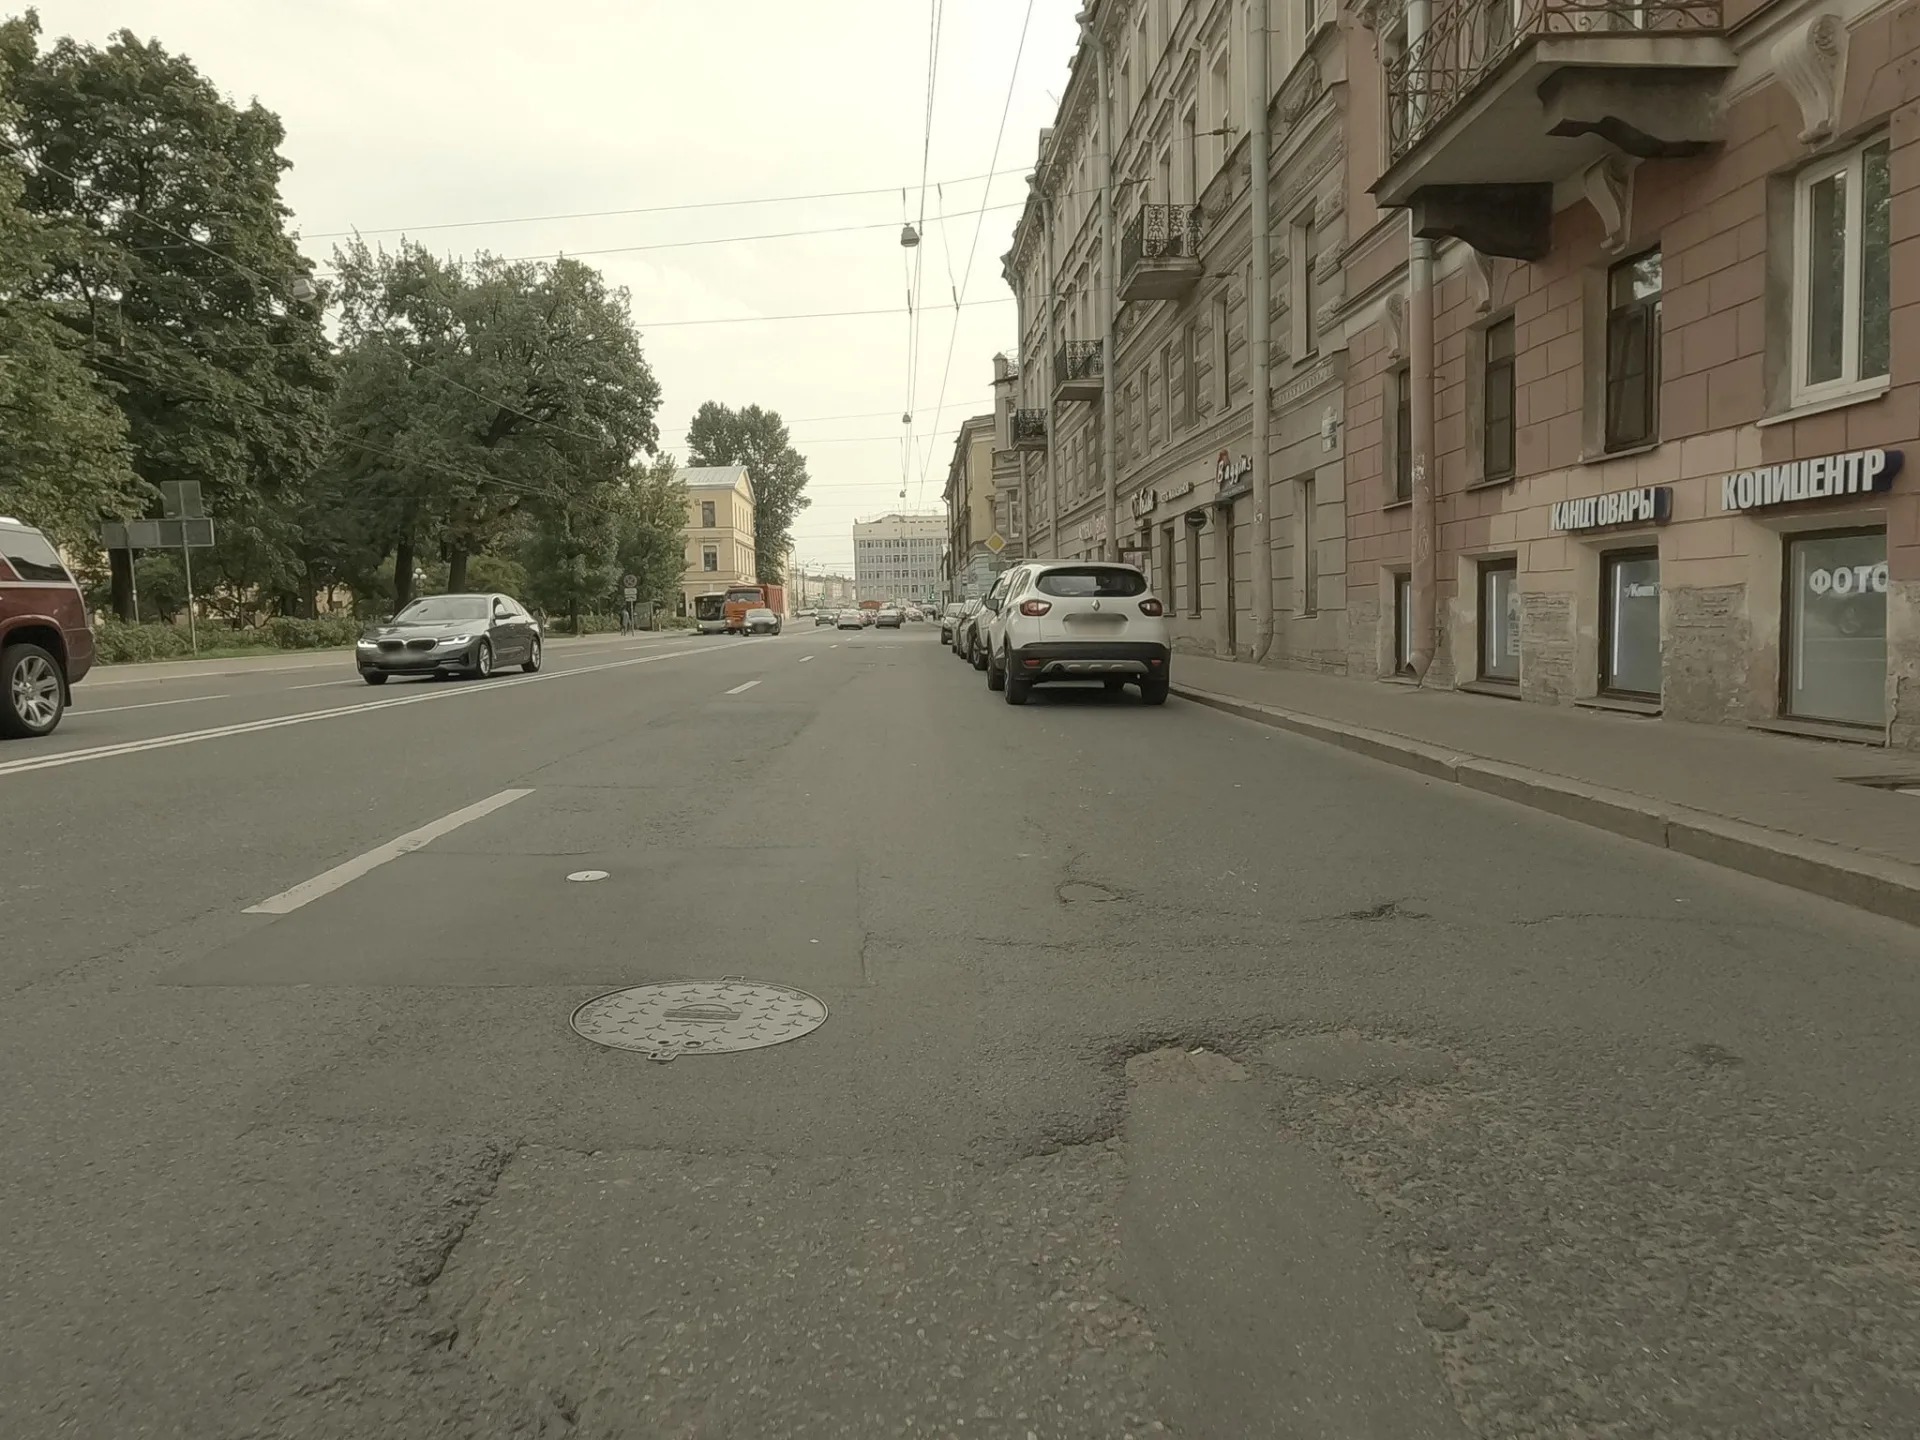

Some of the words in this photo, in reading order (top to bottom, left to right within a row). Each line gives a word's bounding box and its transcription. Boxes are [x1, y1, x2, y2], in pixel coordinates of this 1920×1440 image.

[1721, 448, 1886, 511] КОПИЦЕНТР
[1551, 486, 1656, 531] КАНЦТОВАРЫ
[1809, 566, 1889, 594] ФОТО
